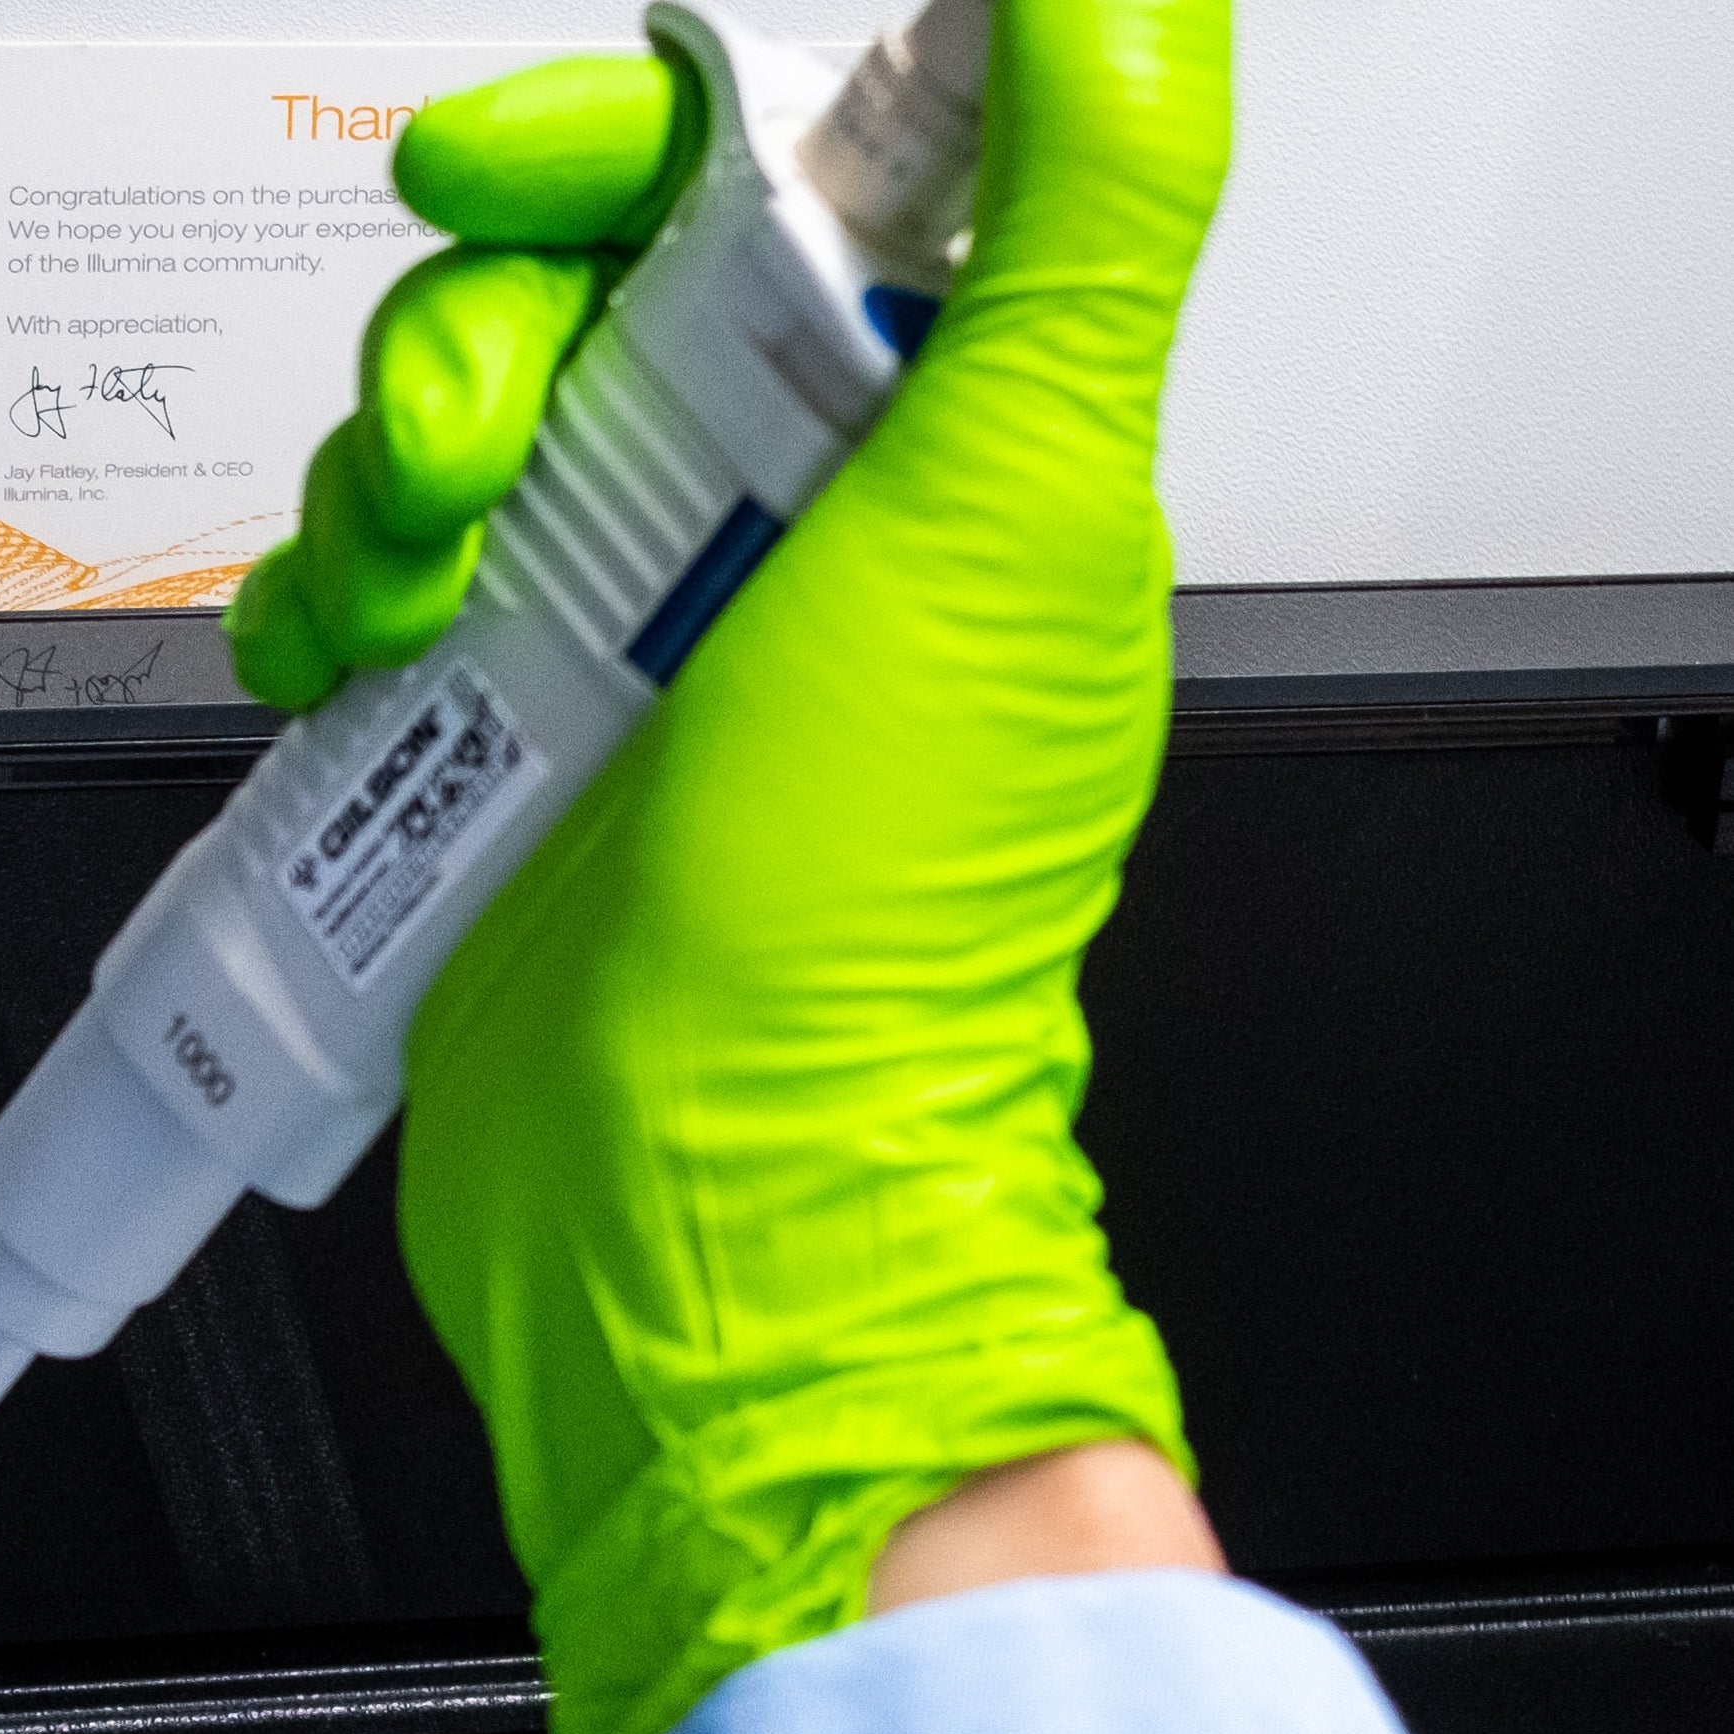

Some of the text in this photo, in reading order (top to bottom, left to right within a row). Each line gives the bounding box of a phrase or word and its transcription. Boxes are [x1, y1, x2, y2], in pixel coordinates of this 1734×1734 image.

[271, 93, 429, 141] Than
[9, 183, 399, 211] Congratulations on the purchas
[8, 221, 49, 239] We
[58, 221, 121, 243] hope
[129, 224, 174, 243] you
[182, 219, 247, 243] enjoy
[254, 223, 309, 242] your
[8, 253, 324, 276] of the Illumina community.
[7, 315, 224, 341] With appreciation,
[4, 462, 253, 483] Jay Flatley, President & CEO
[4, 486, 109, 501] Illumina, Inc.
[166, 1015, 234, 1106] 1000
